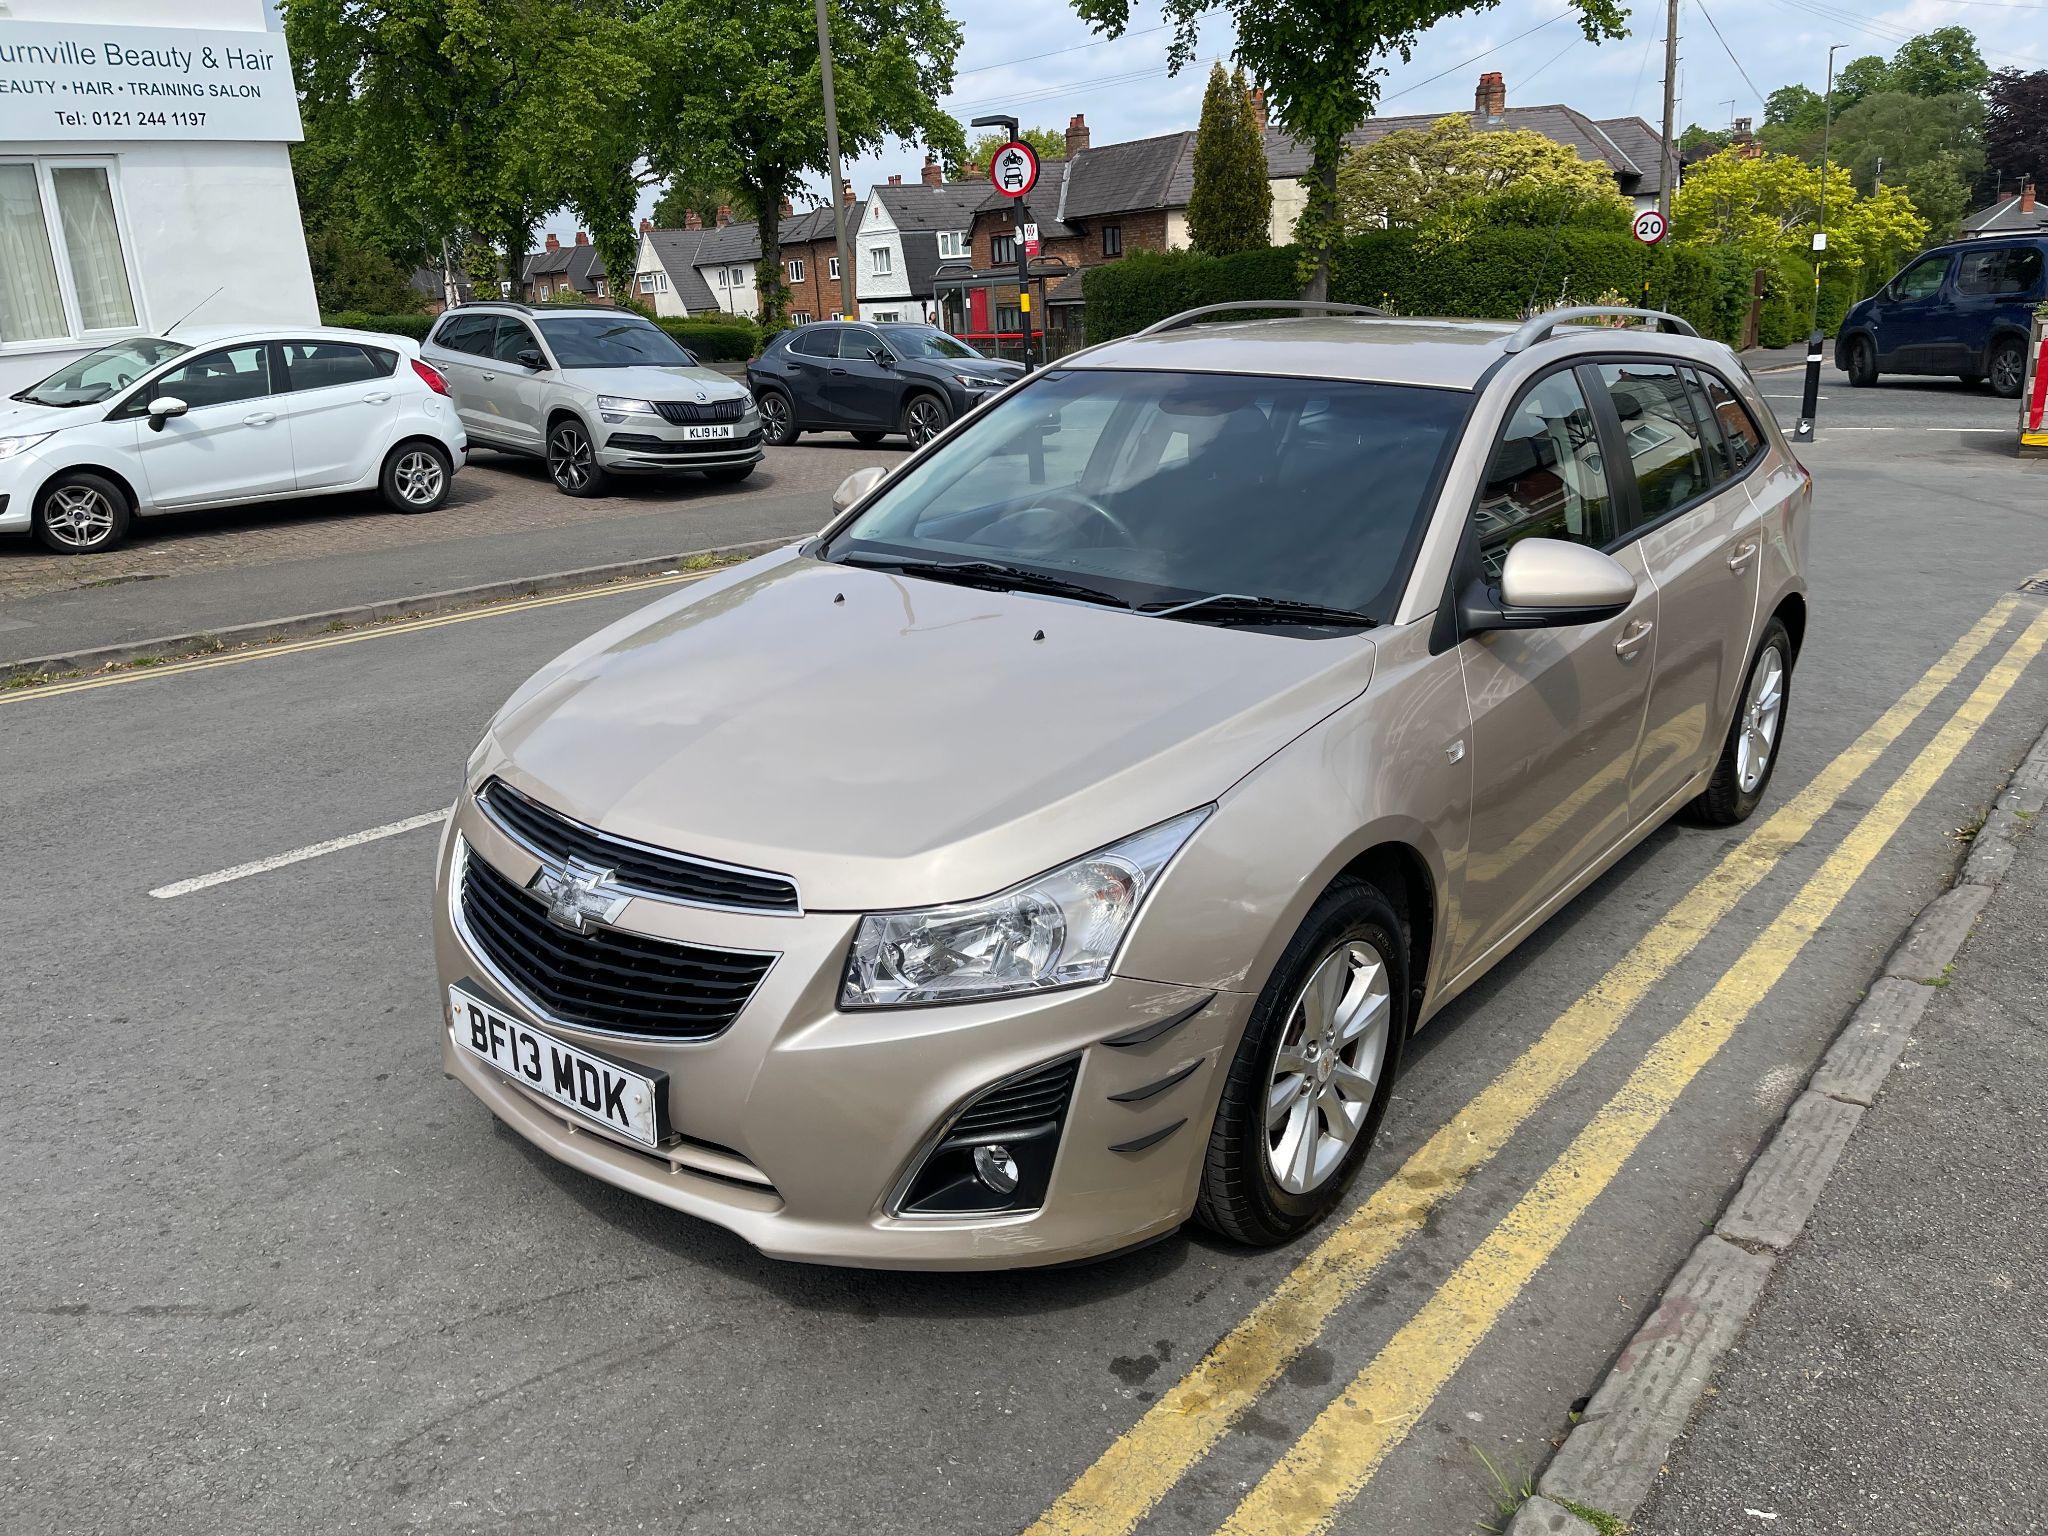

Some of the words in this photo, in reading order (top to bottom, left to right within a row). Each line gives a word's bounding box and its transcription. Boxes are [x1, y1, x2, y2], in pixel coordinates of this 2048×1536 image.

[0, 41, 97, 66] urnville
[103, 42, 192, 74] Beauty
[201, 46, 220, 69] &
[225, 47, 273, 71] Hair
[0, 79, 56, 94] EAUTY
[72, 81, 115, 96] HAIR
[128, 82, 205, 97] TRAINING
[208, 84, 261, 98] SALON
[54, 111, 87, 126] Tel:
[92, 111, 132, 126] 0121
[138, 112, 166, 126] 244
[171, 112, 207, 126] 1197
[1638, 221, 1661, 235] 20
[690, 427, 710, 438] KL19
[712, 426, 729, 437] HJN
[467, 1002, 542, 1083] BF13
[551, 1045, 630, 1128] MDK
